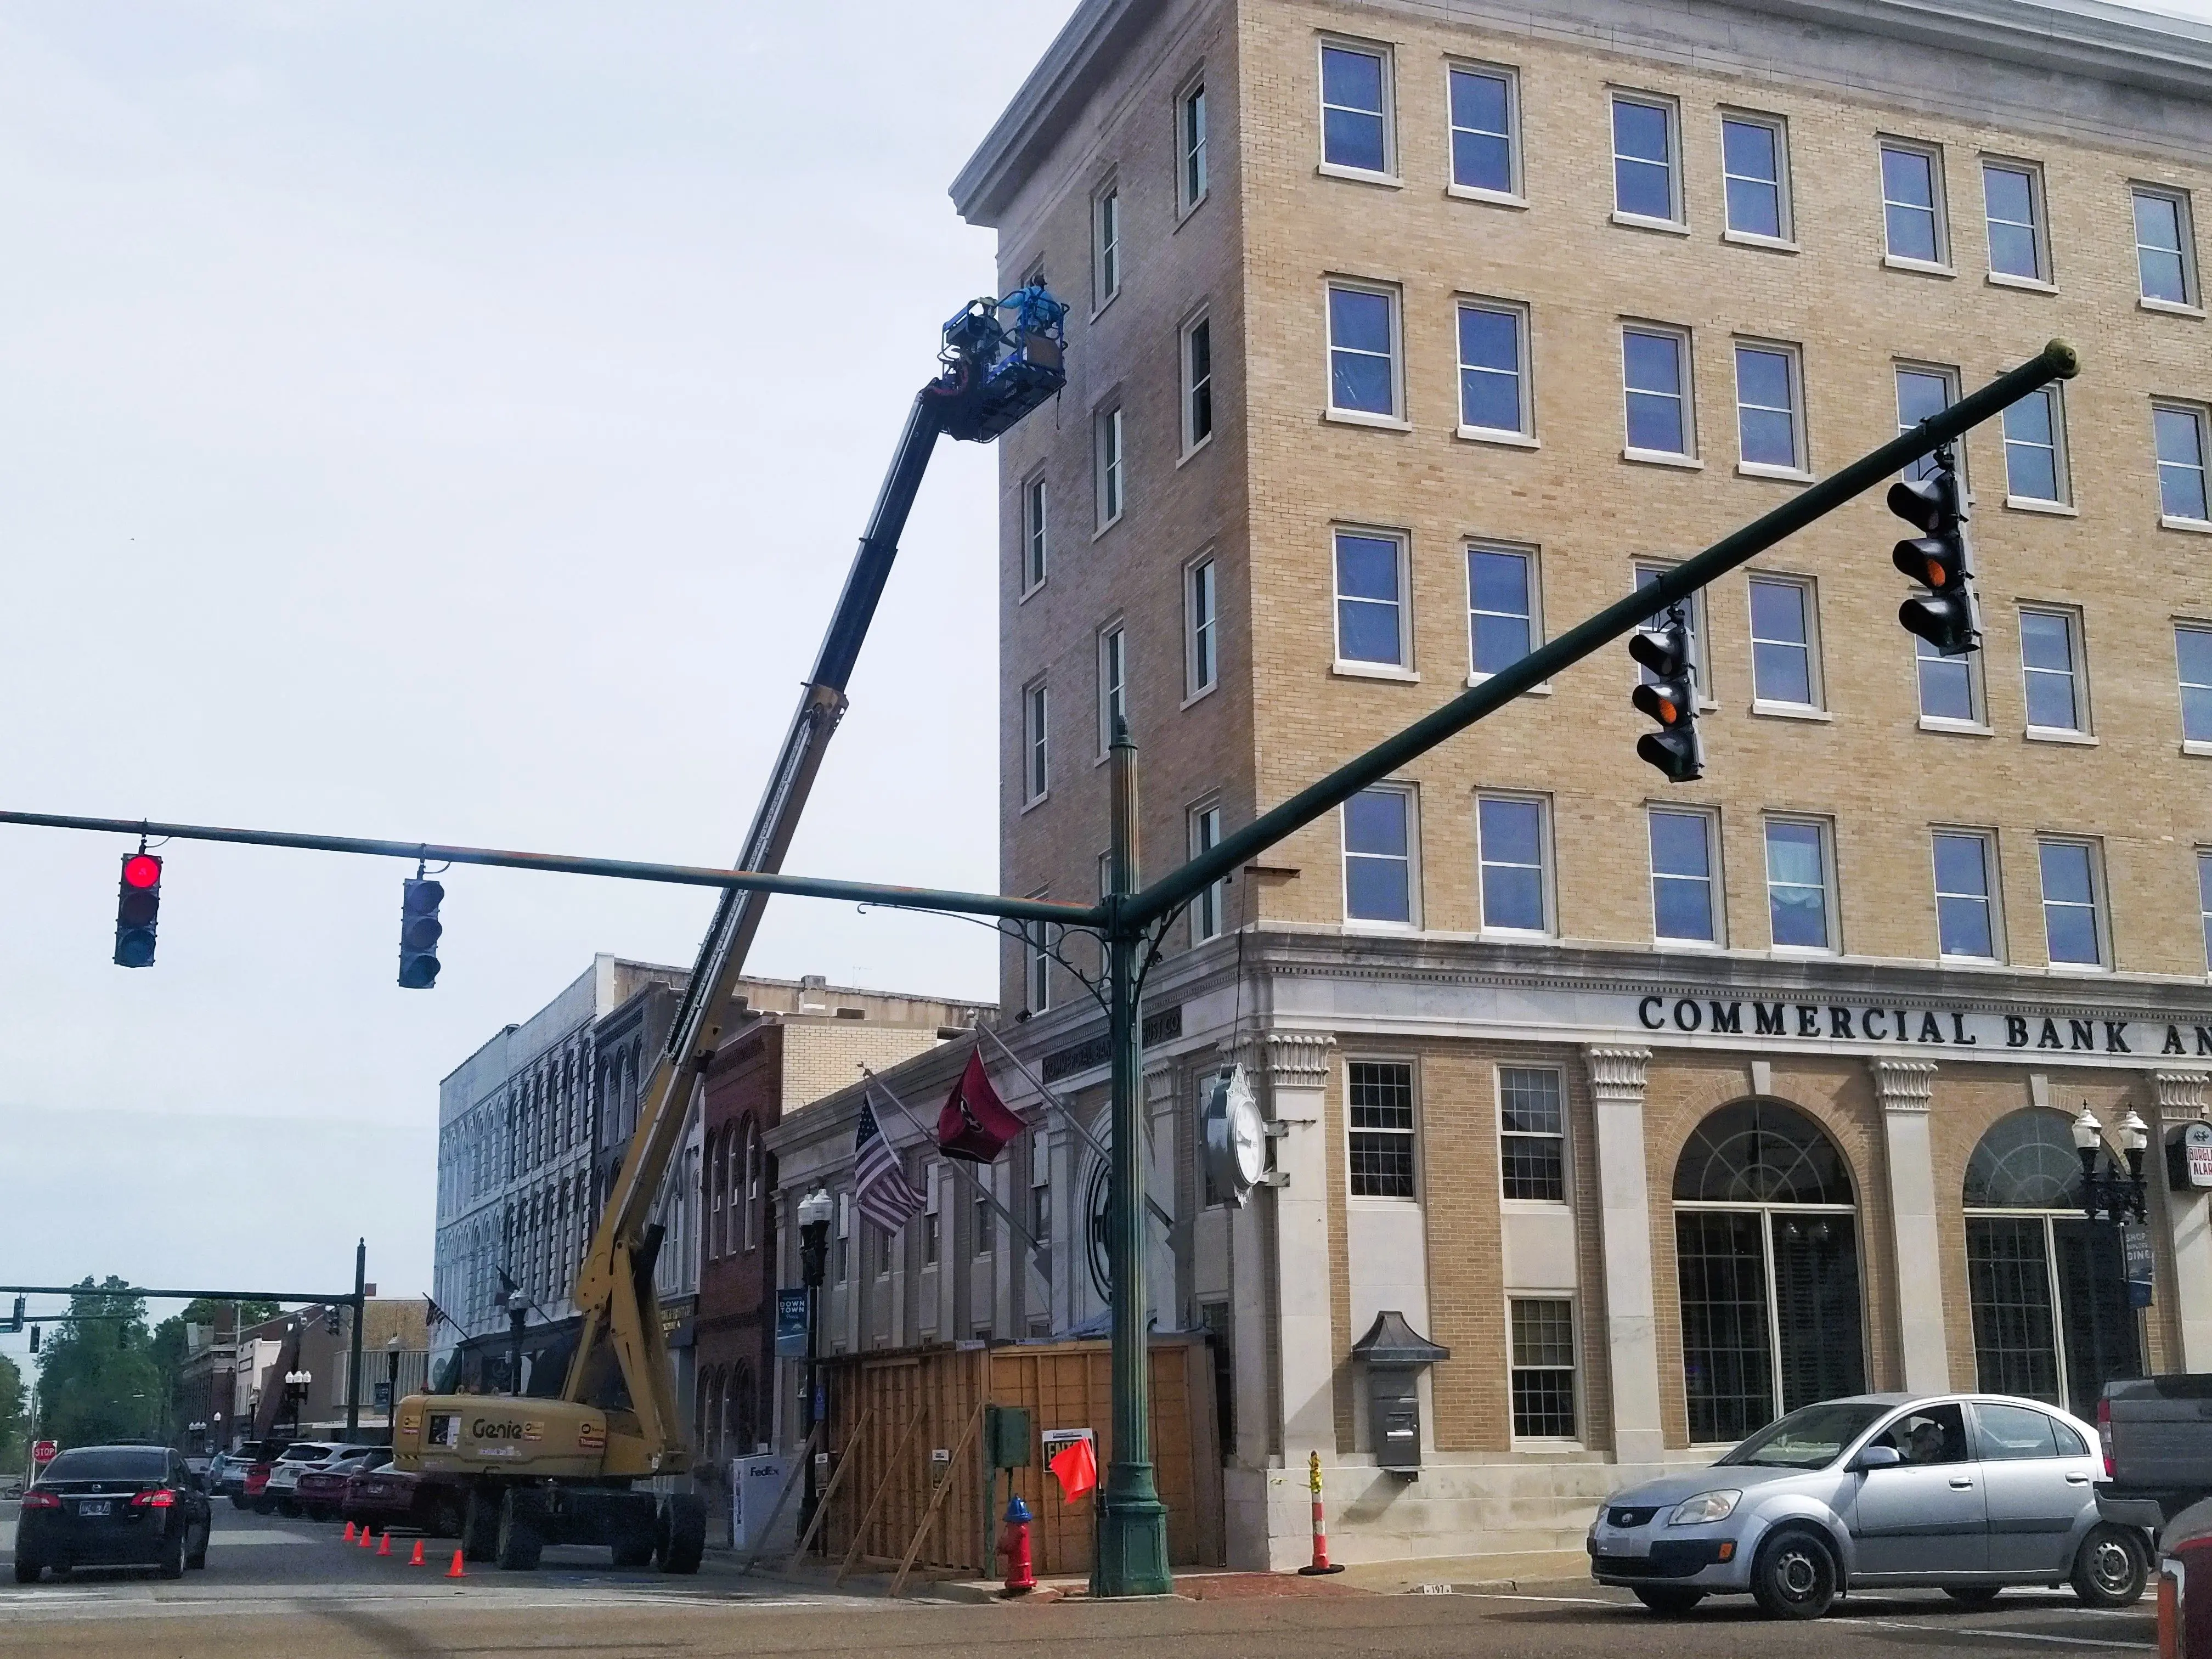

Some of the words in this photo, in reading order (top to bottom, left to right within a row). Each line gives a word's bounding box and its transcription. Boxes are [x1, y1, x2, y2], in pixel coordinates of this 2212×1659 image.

[1639, 996, 1976, 1046] COMMERCIAL
[2005, 1014, 2132, 1053] BANK
[1045, 1045, 1093, 1077] COMMERCIAL
[1096, 1040, 1111, 1059] BAN
[1142, 1019, 1163, 1042] RUST
[2189, 1148, 2212, 1161] BURGL
[2126, 1233, 2145, 1242] SHOP
[2128, 1250, 2150, 1260] DINE
[473, 1418, 522, 1439] Genie
[35, 1448, 54, 1456] STOP
[751, 1466, 779, 1476] FedEx
[1432, 1584, 1444, 1594] 197
